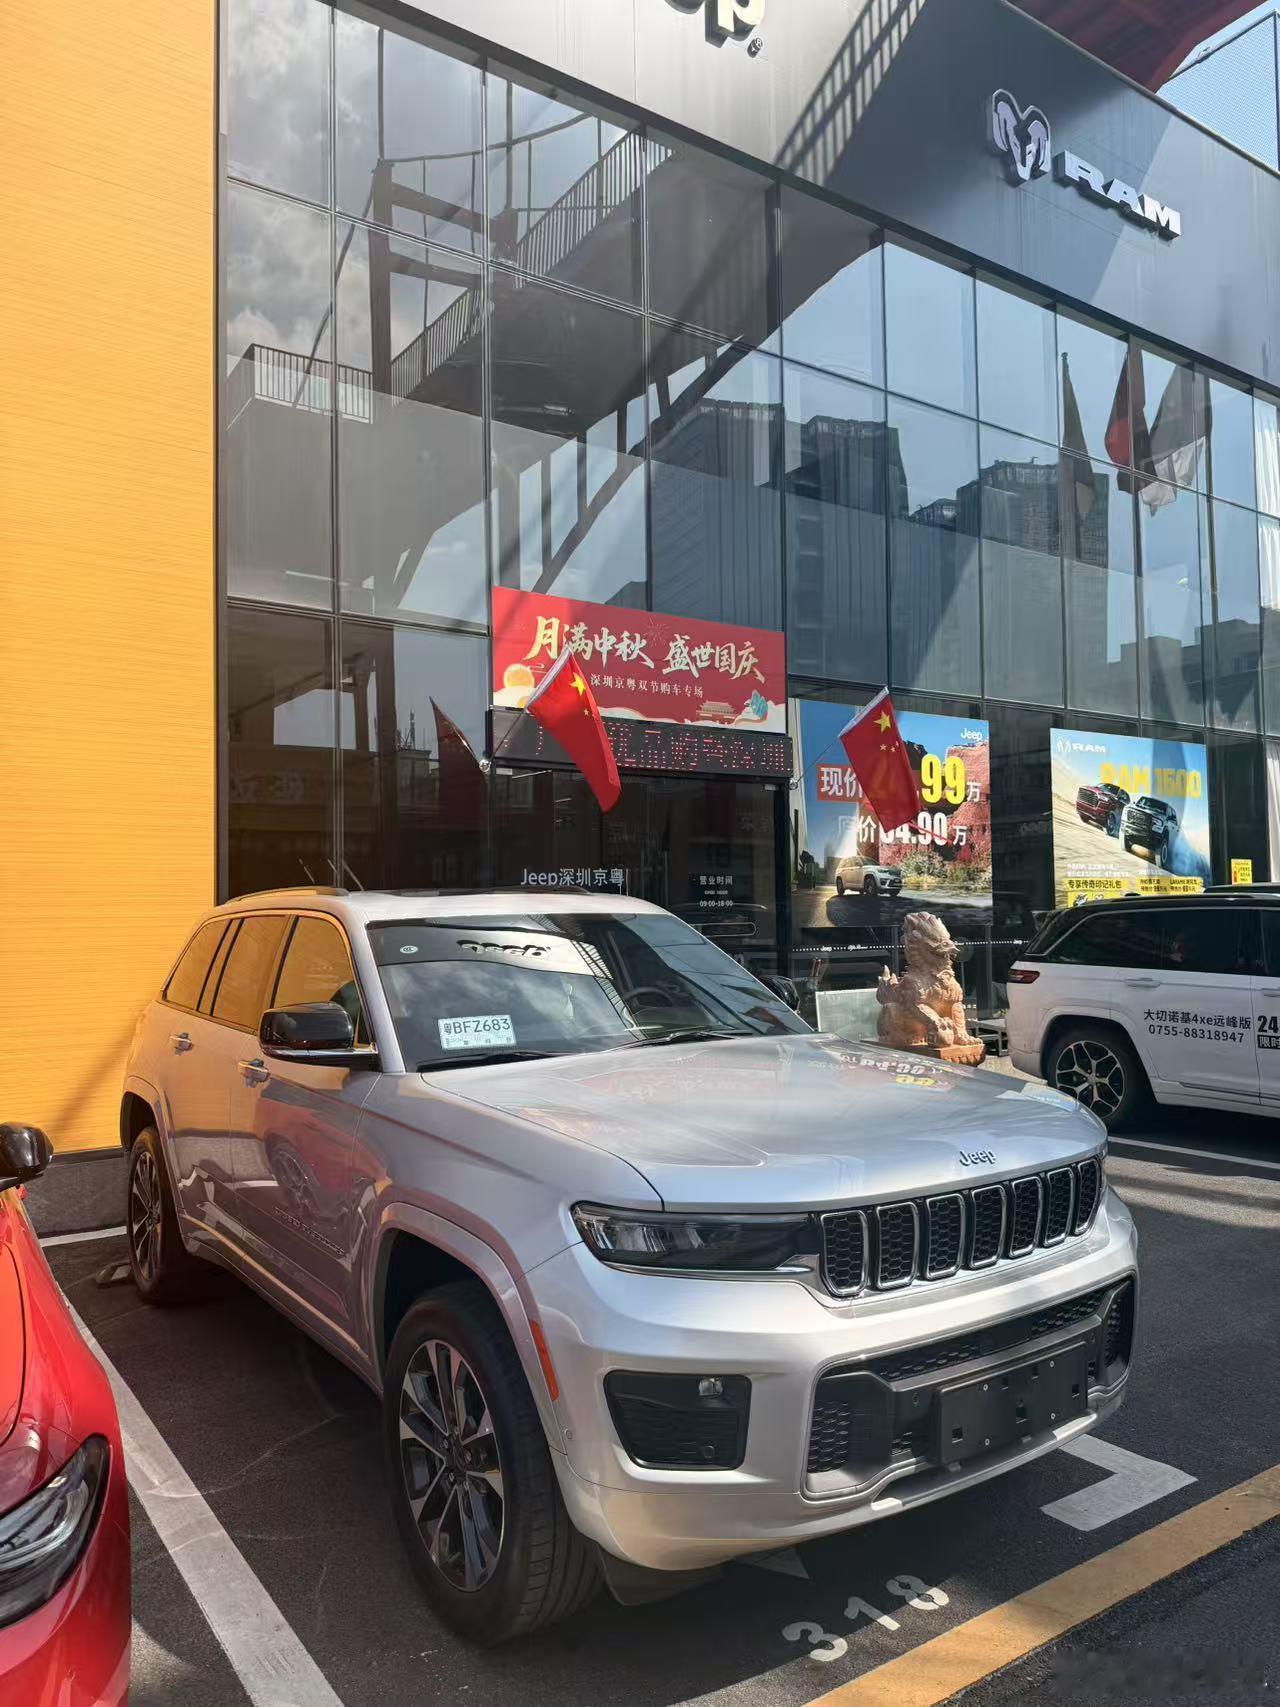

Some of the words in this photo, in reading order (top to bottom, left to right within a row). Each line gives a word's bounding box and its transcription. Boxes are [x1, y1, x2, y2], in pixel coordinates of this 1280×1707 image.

[1056, 150, 1181, 238] RAM
[523, 615, 655, 669] 月满中秋
[662, 633, 766, 684] 盛世国庆
[590, 673, 703, 699] 深圳京粤双节购车专场
[960, 728, 982, 742] Jeep
[1072, 743, 1106, 753] RAM
[920, 753, 981, 805] 99万
[1100, 763, 1150, 794] RAM
[1153, 767, 1202, 798] 1500
[521, 868, 625, 887] Jeep深圳京粤
[699, 875, 733, 885] 营业时间
[1068, 879, 1121, 889] 专享传奇印记礼包
[1143, 1008, 1252, 1030] 大切诺基4xe远峰版
[1148, 1024, 1245, 1043] 0755-88318947
[960, 1150, 996, 1167] Jeep
[782, 1575, 949, 1662] 318
